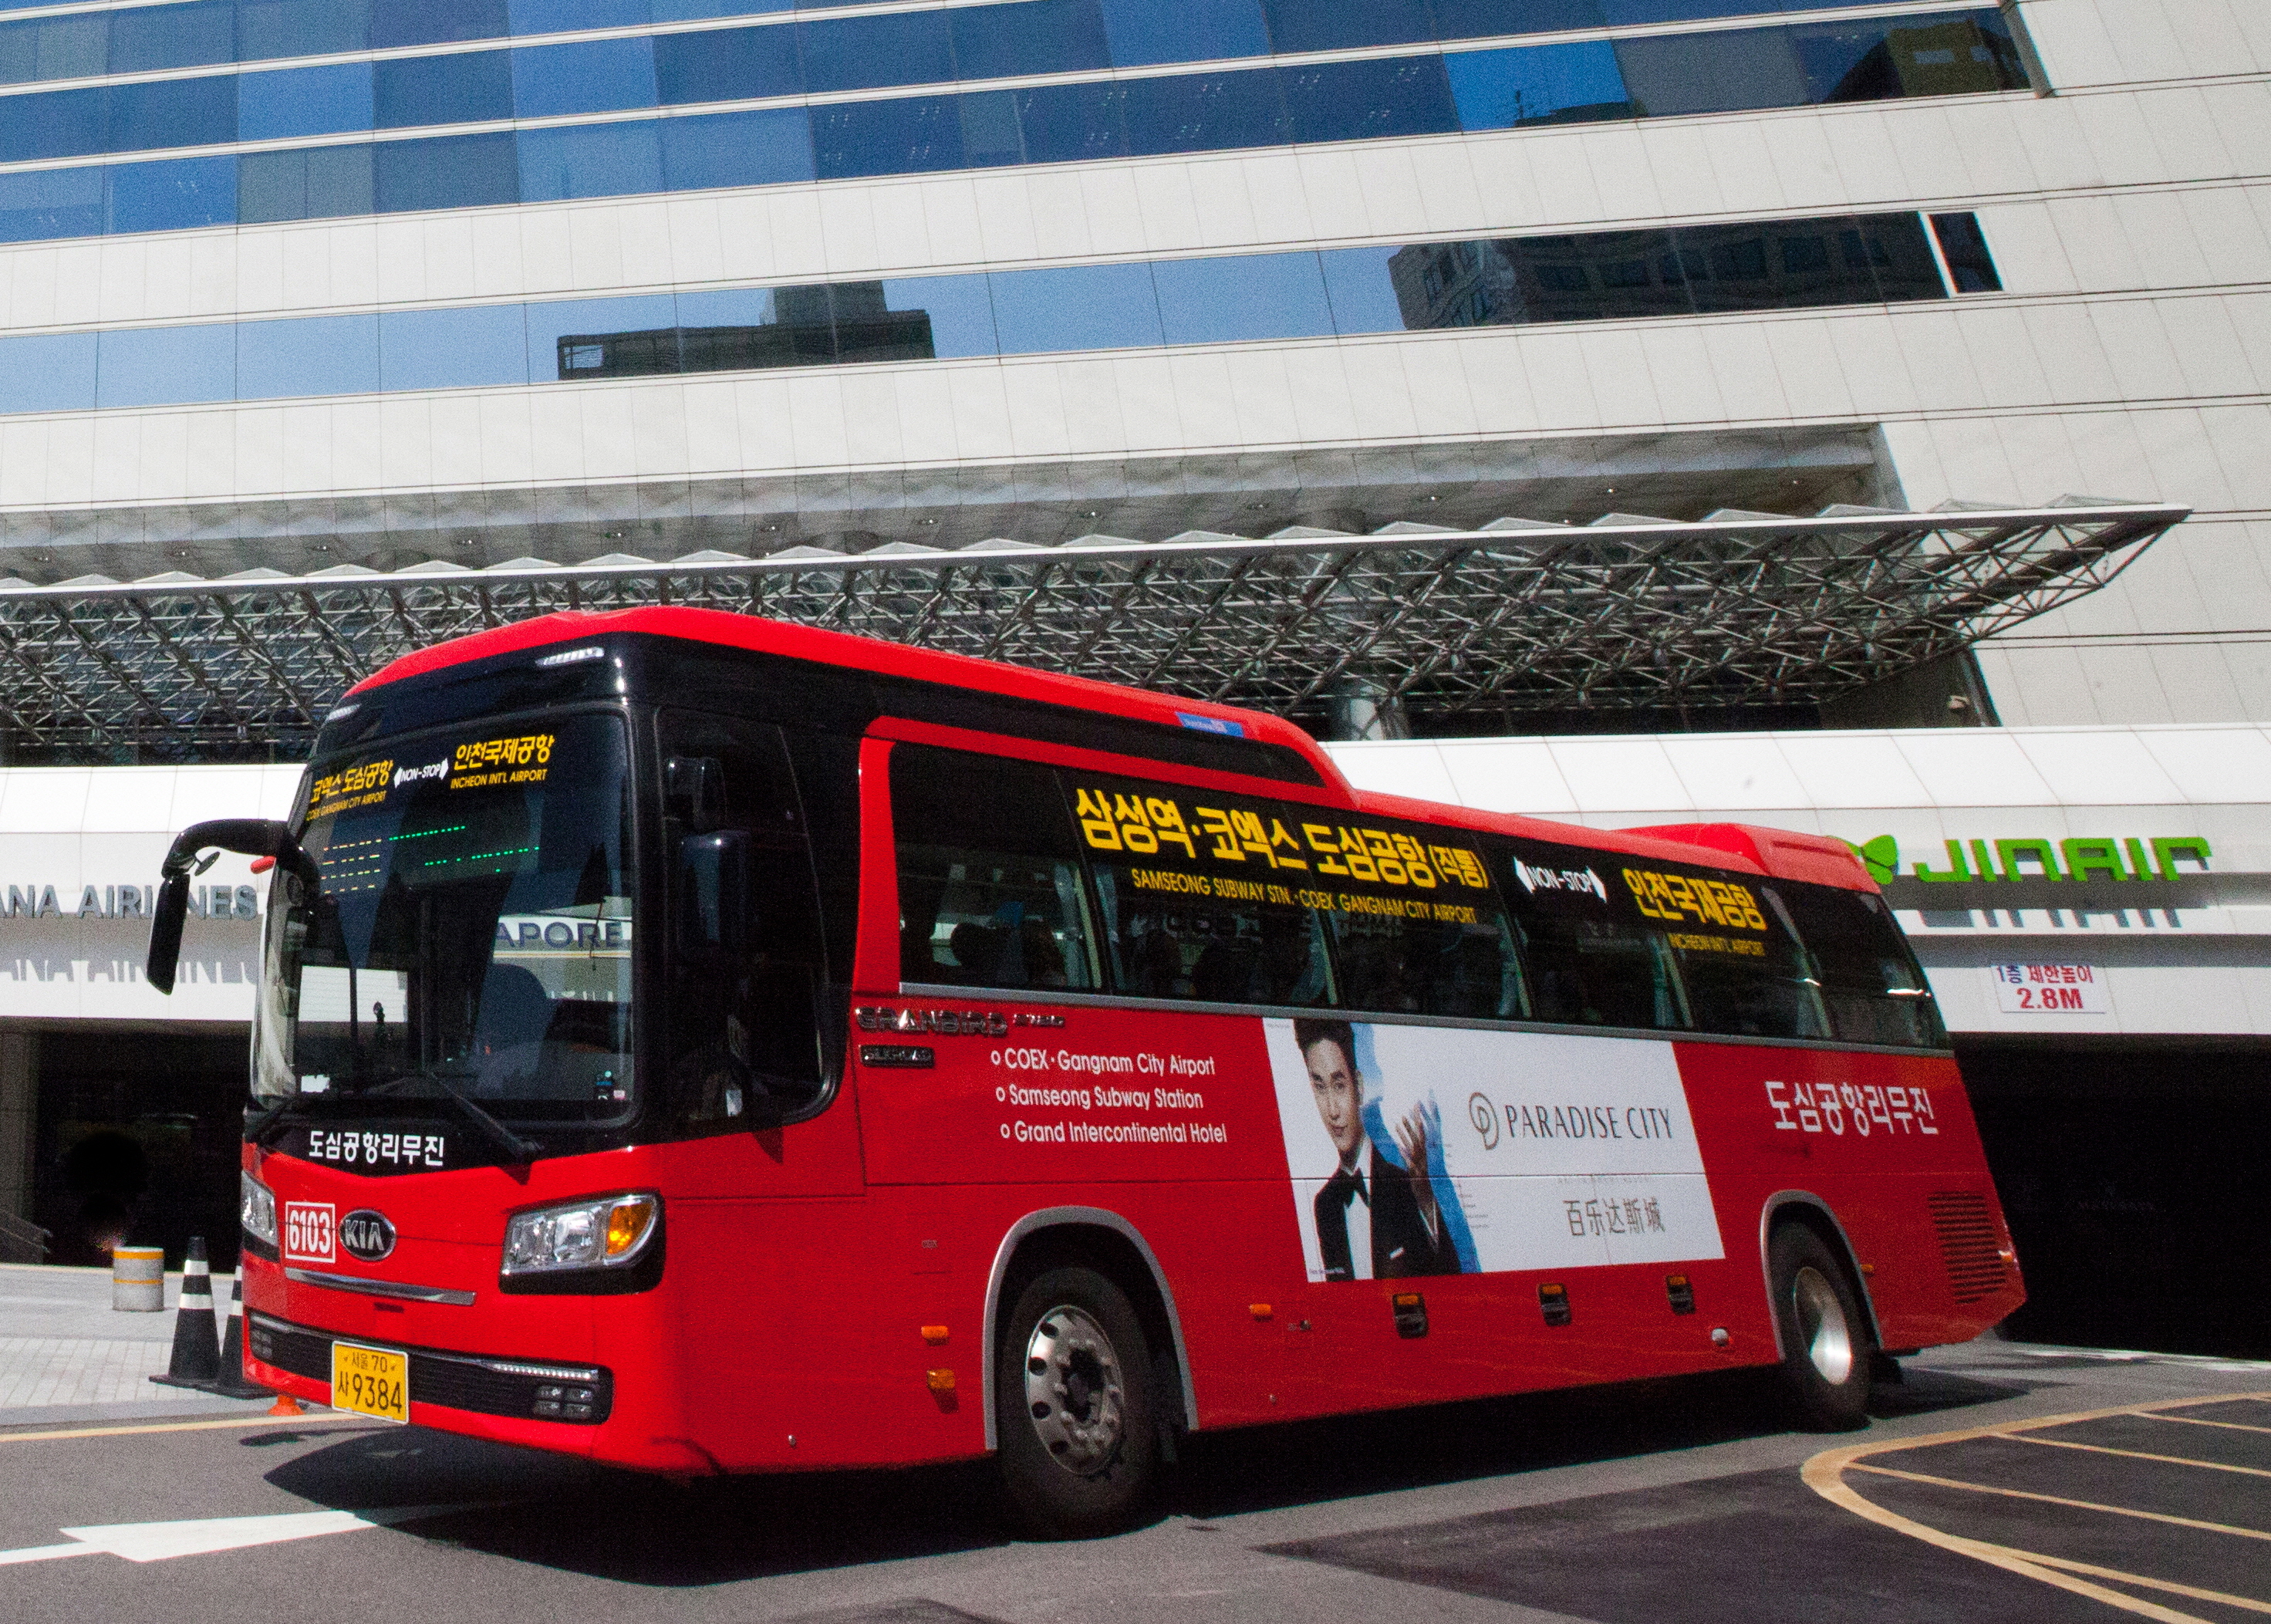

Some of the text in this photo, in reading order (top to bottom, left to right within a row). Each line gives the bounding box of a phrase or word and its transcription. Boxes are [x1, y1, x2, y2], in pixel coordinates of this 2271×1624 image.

[454, 734, 555, 771] 인천국제공항
[342, 759, 393, 793] 도심공항
[400, 764, 442, 783] NON-STOP
[450, 775, 487, 790] INCHEON
[510, 768, 548, 782] AIRPORT
[1525, 865, 1594, 893] NON-STOP
[0, 885, 258, 921] NA AIRLNES
[1131, 868, 1211, 895] SAMSEONG
[1213, 877, 1265, 902] SUBWAY
[1339, 893, 1406, 917] GANGNAM
[1405, 900, 1430, 920] CITY
[1432, 903, 1476, 924] AIRPORT
[1621, 867, 1769, 931] 인천국제공항
[2016, 987, 2084, 1010] 2.8M
[1137, 1053, 1164, 1077] City
[1169, 1054, 1216, 1078] Airport
[1009, 1083, 1203, 1111] Samseong Subway Station
[1763, 1080, 1939, 1137] 도심공항리무진
[1014, 1119, 1228, 1143] Grand Intercontinental Hotel
[1505, 1104, 1672, 1140] PARADISE CITY
[309, 1130, 444, 1167] 도심공항리무진
[289, 1209, 332, 1254] 6103
[344, 1219, 385, 1251] KIA
[371, 1354, 388, 1373] 70
